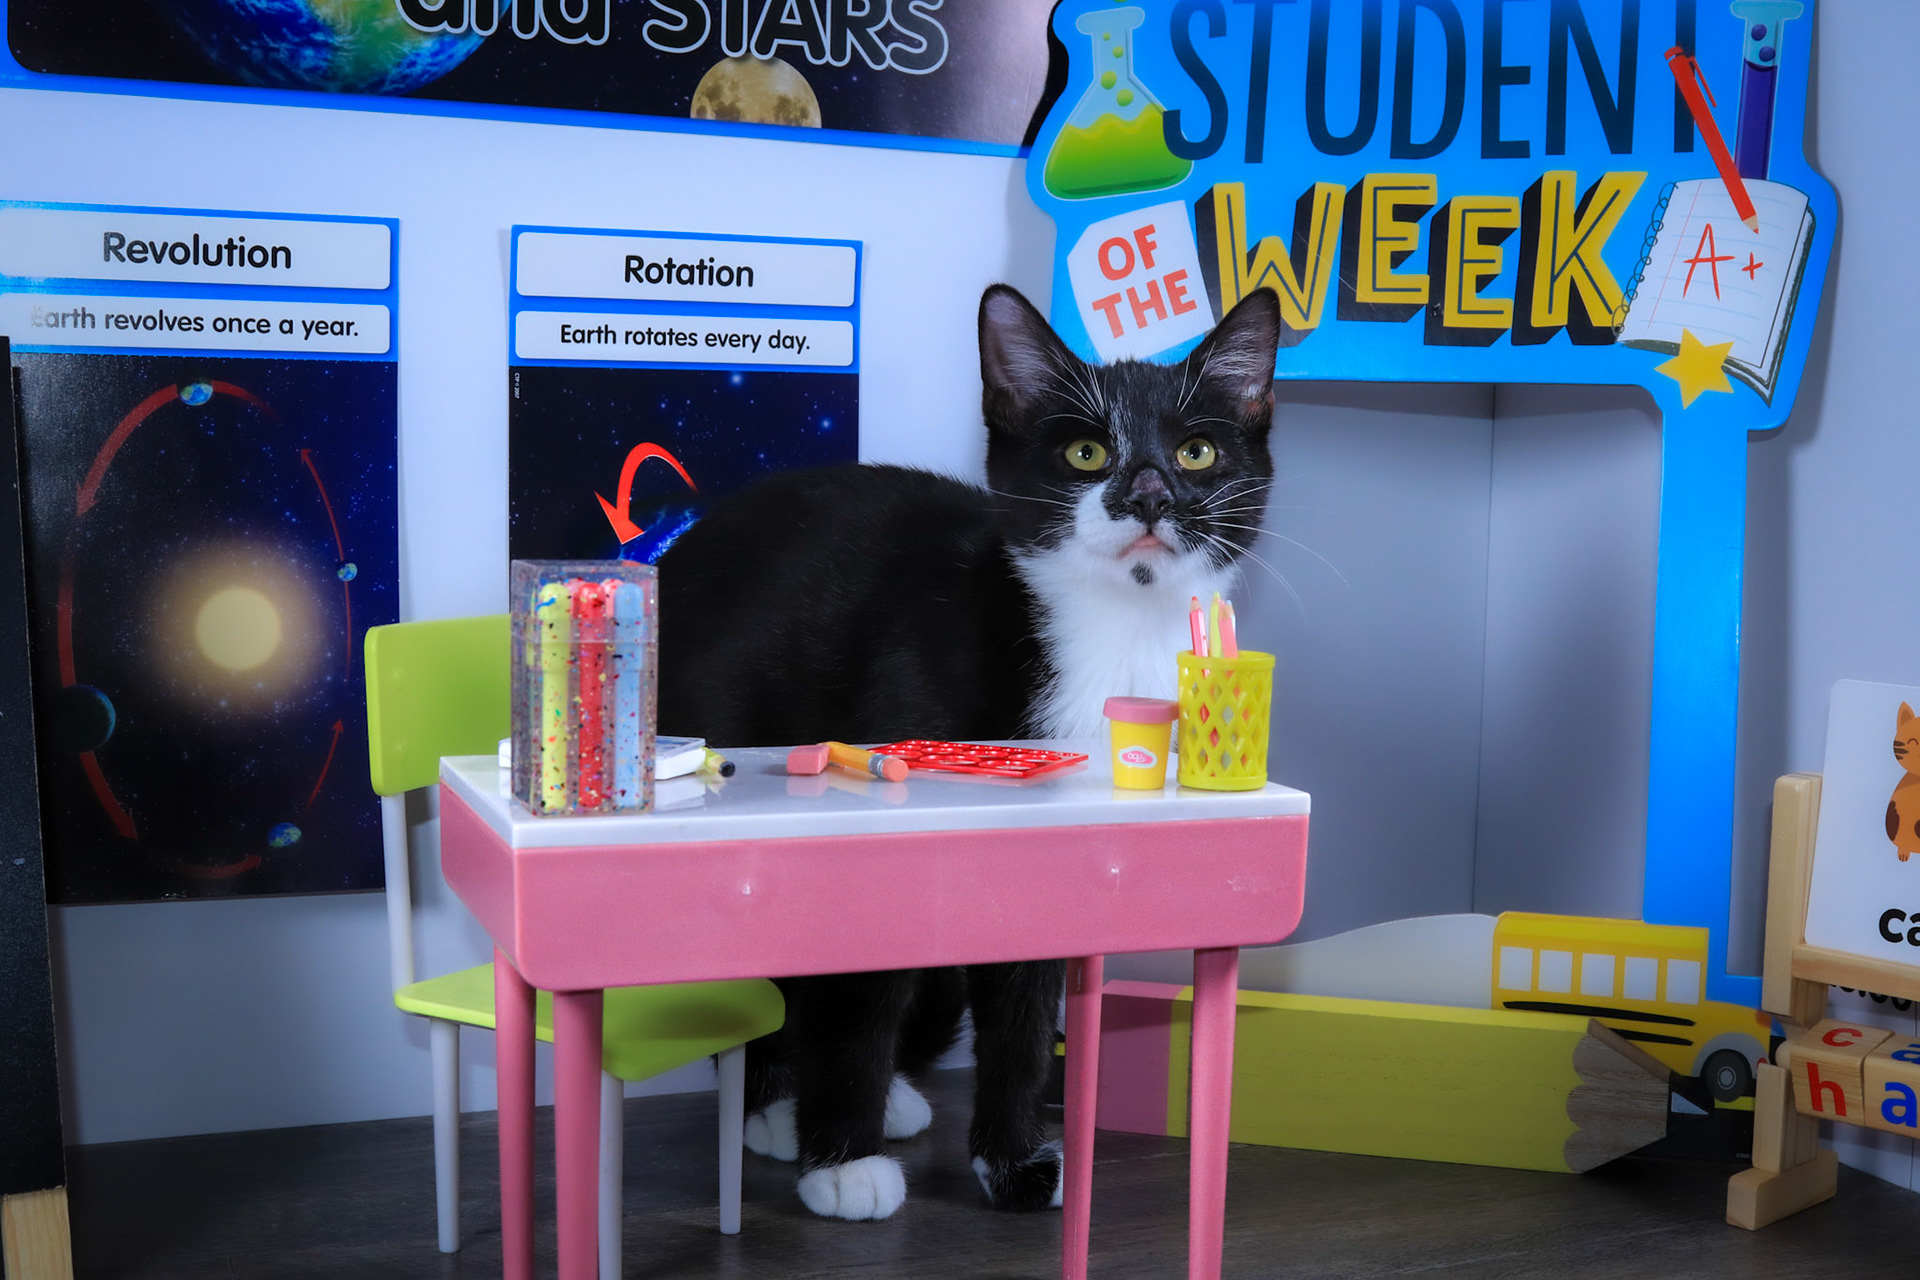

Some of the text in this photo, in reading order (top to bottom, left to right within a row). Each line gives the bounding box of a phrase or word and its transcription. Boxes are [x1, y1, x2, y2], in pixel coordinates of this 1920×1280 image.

[1163, 0, 1700, 163] STUDENT
[102, 231, 292, 269] Revolution
[624, 254, 754, 287] Rotation
[1097, 223, 1158, 281] OF
[1196, 170, 1649, 346] WEEK
[1682, 222, 1764, 301] A+
[30, 305, 359, 340] Earth revolves once a year.
[1091, 268, 1197, 339] THE
[560, 324, 810, 354] Earth rotates every day.
